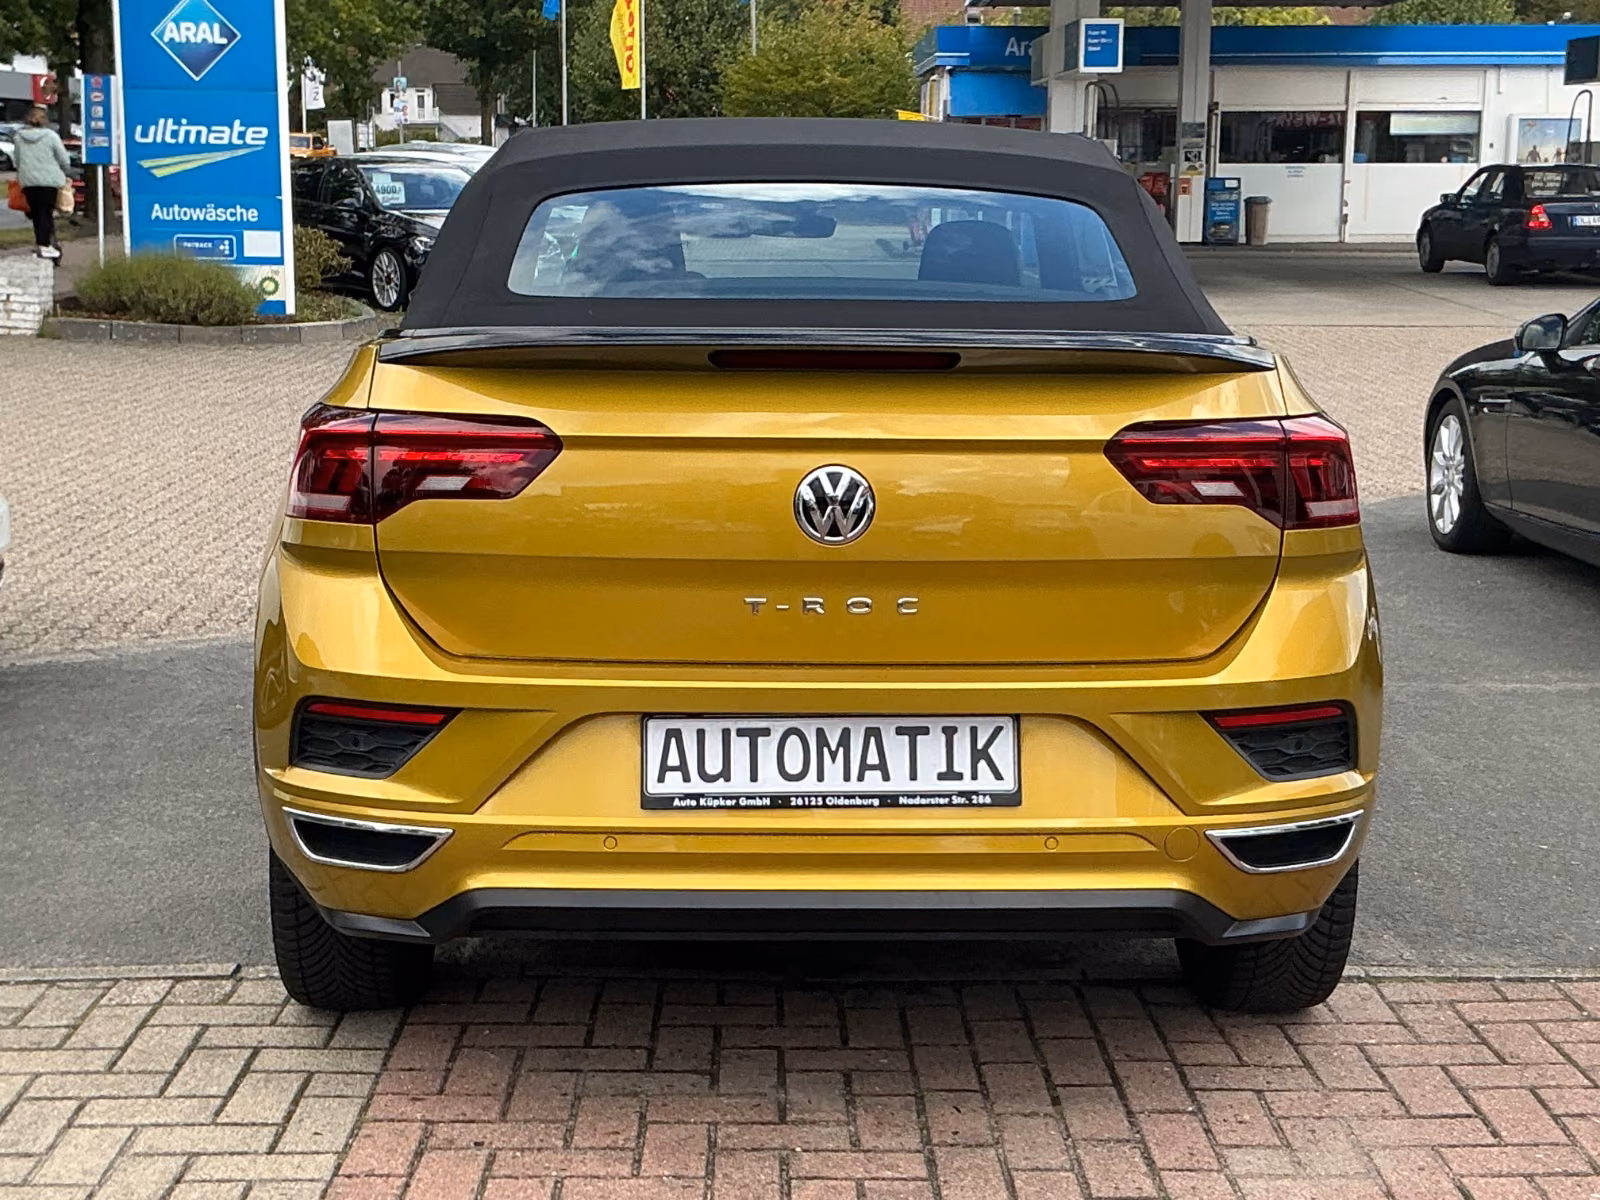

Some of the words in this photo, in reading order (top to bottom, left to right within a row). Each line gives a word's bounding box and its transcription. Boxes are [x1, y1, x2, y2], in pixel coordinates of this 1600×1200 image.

[163, 21, 228, 45] ARAL
[134, 118, 268, 146] ultimate
[151, 203, 259, 223] Autowäsche
[656, 725, 1005, 783] AUTOMATIK
[672, 797, 697, 807] Auto
[700, 797, 737, 808] Küpker
[739, 796, 770, 806] GmbH
[790, 796, 823, 806] 26125
[825, 795, 880, 807] Oldenburg
[951, 795, 969, 805] Str.
[971, 794, 992, 804] 286
